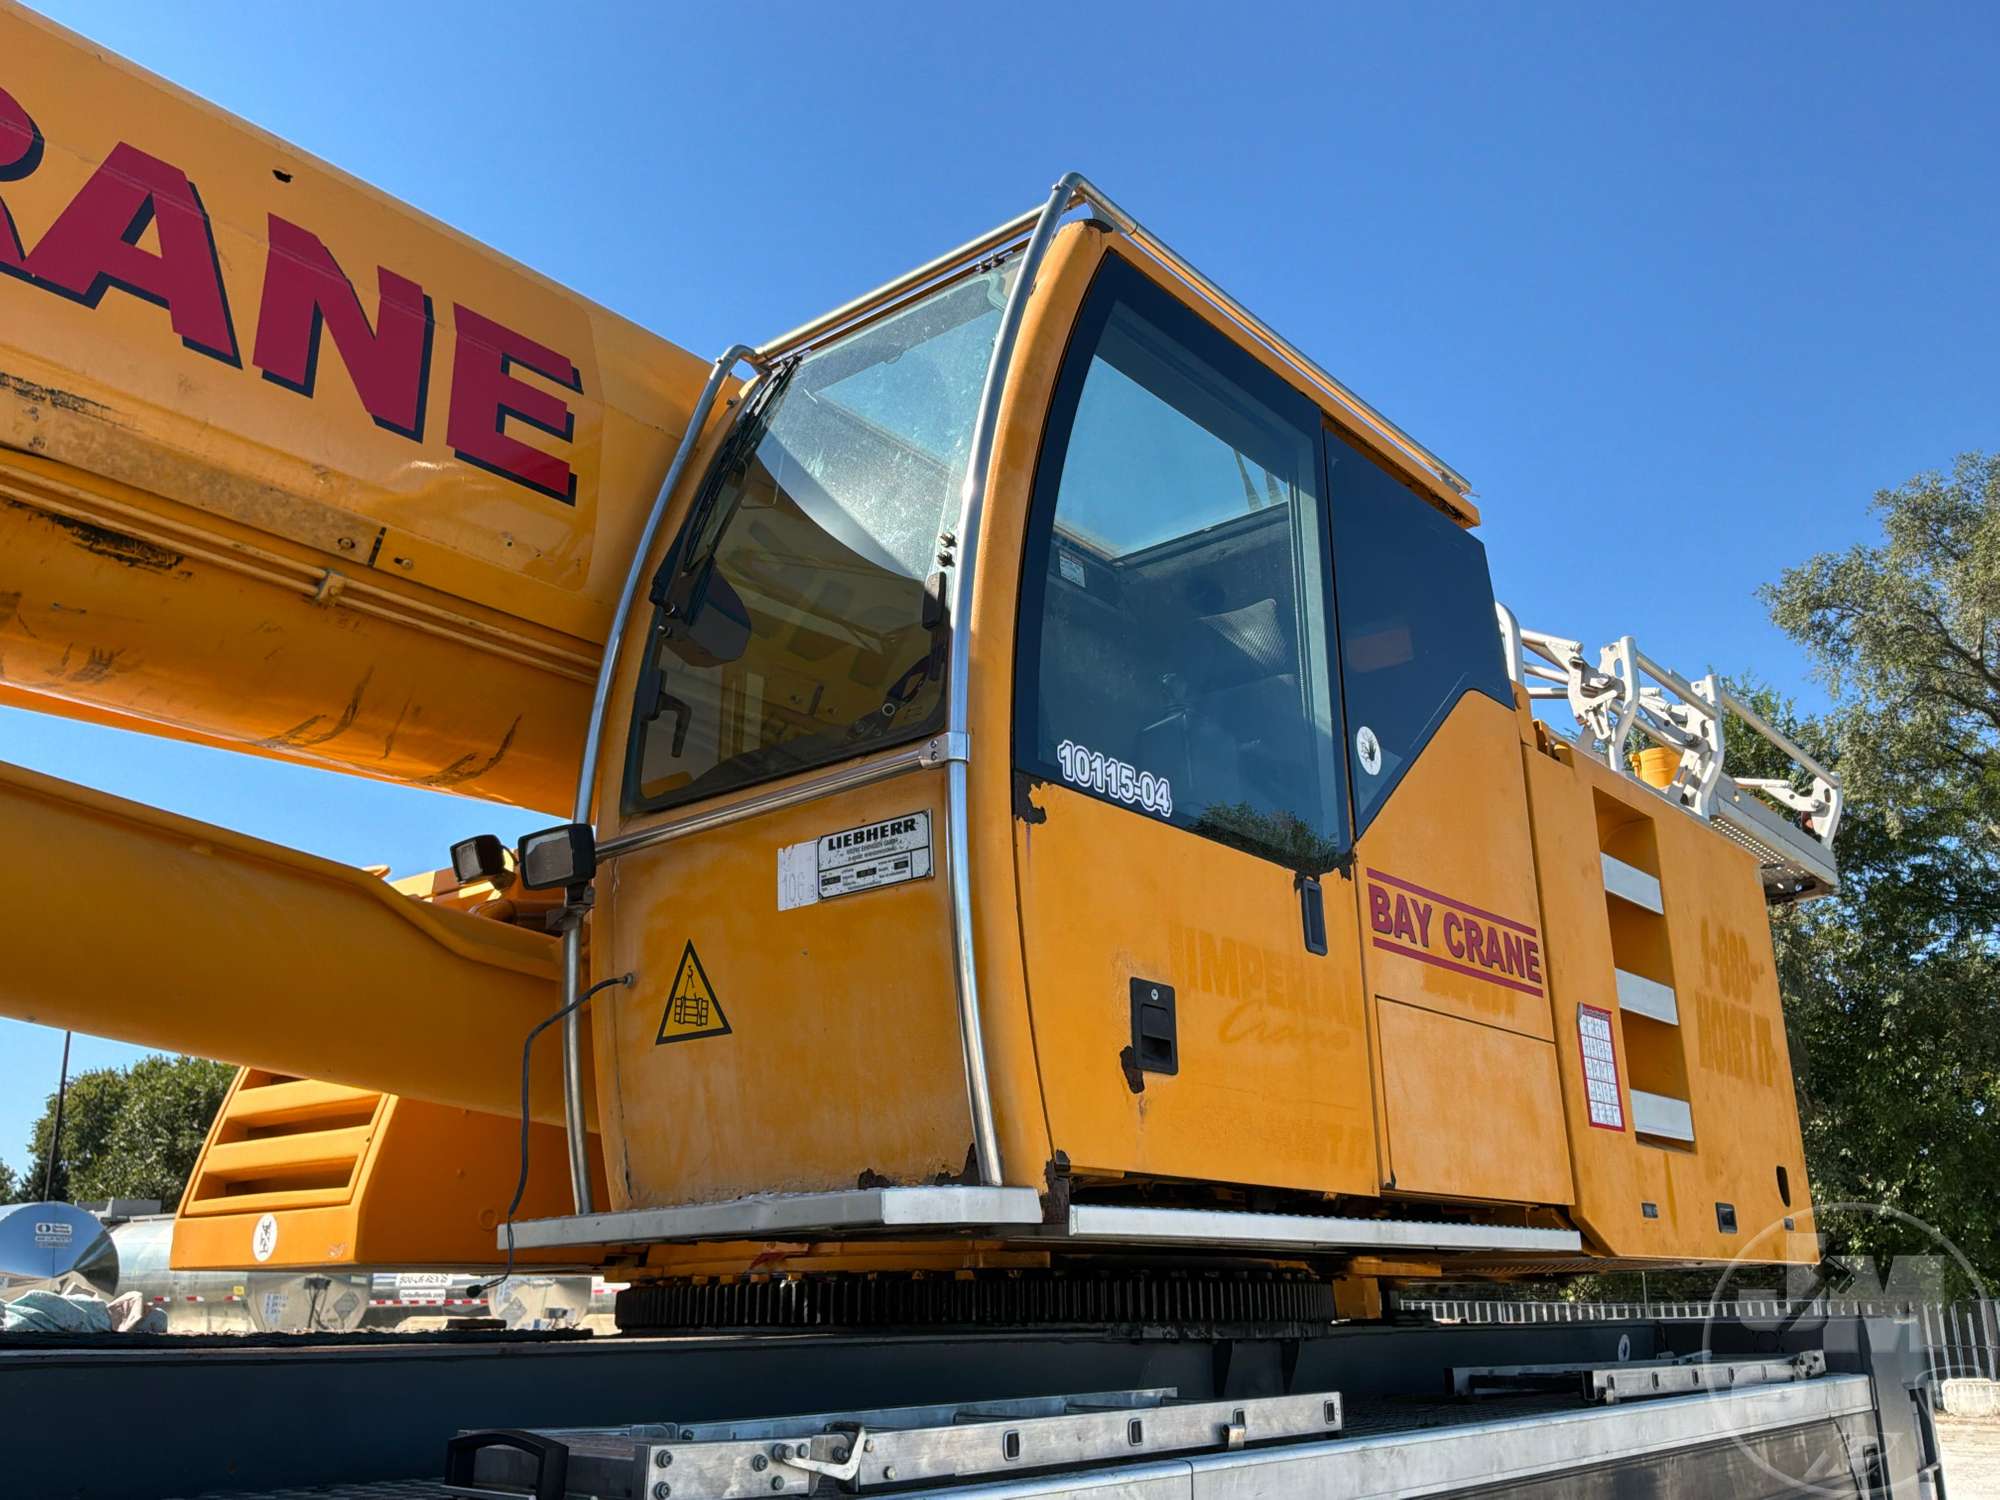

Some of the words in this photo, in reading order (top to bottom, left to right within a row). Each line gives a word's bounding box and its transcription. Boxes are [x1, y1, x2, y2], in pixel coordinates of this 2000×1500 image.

[0, 87, 584, 507] ANE
[1057, 740, 1172, 818] 10115-04
[828, 818, 917, 852] LIEBHERR
[1368, 882, 1433, 948] BAY
[1443, 911, 1542, 984] CRANE
